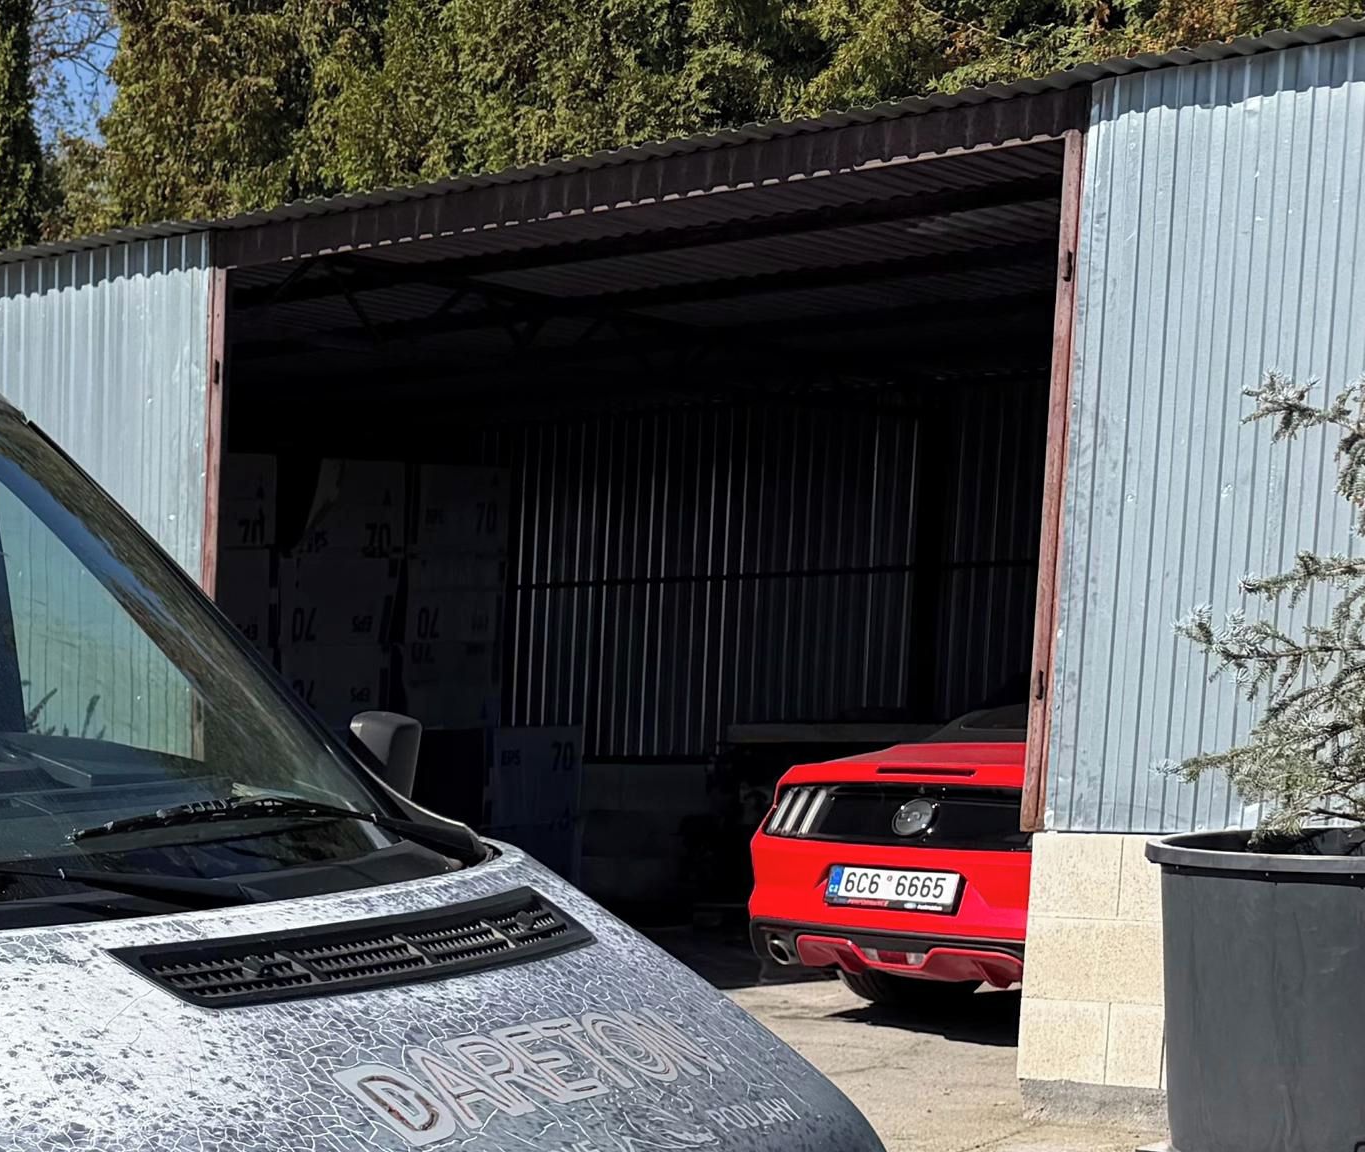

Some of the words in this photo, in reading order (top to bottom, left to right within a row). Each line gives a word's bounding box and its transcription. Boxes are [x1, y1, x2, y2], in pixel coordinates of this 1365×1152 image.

[476, 502, 497, 535] 70
[292, 607, 317, 641] 70
[551, 741, 574, 771] 70
[844, 872, 881, 894] 6C6
[894, 875, 946, 899] 6665
[334, 1007, 726, 1147] DARETON
[705, 1098, 801, 1133] PODLAHY
